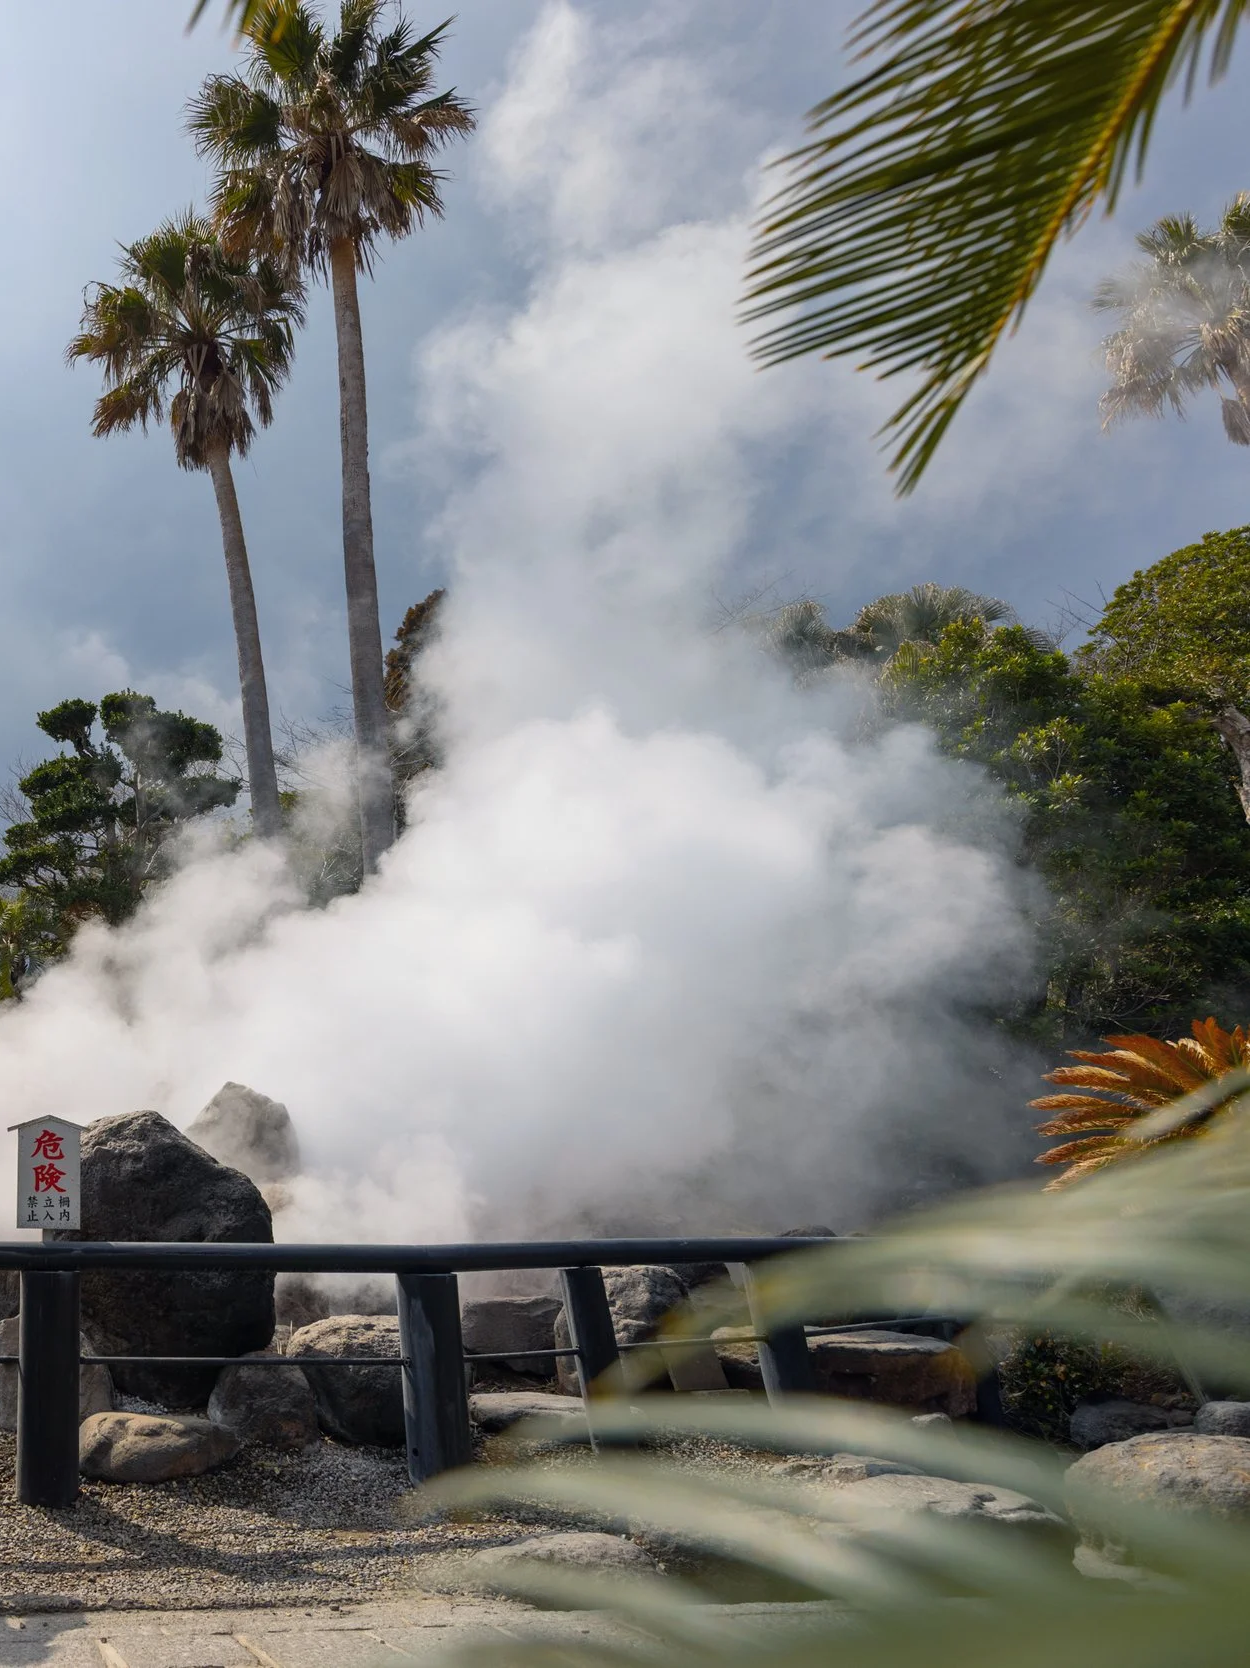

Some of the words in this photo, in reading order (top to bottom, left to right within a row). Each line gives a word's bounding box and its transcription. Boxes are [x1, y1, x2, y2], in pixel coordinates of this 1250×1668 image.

[31, 1130, 66, 1193] 危険
[27, 1196, 39, 1222] 禁止
[43, 1196, 55, 1220] 立入
